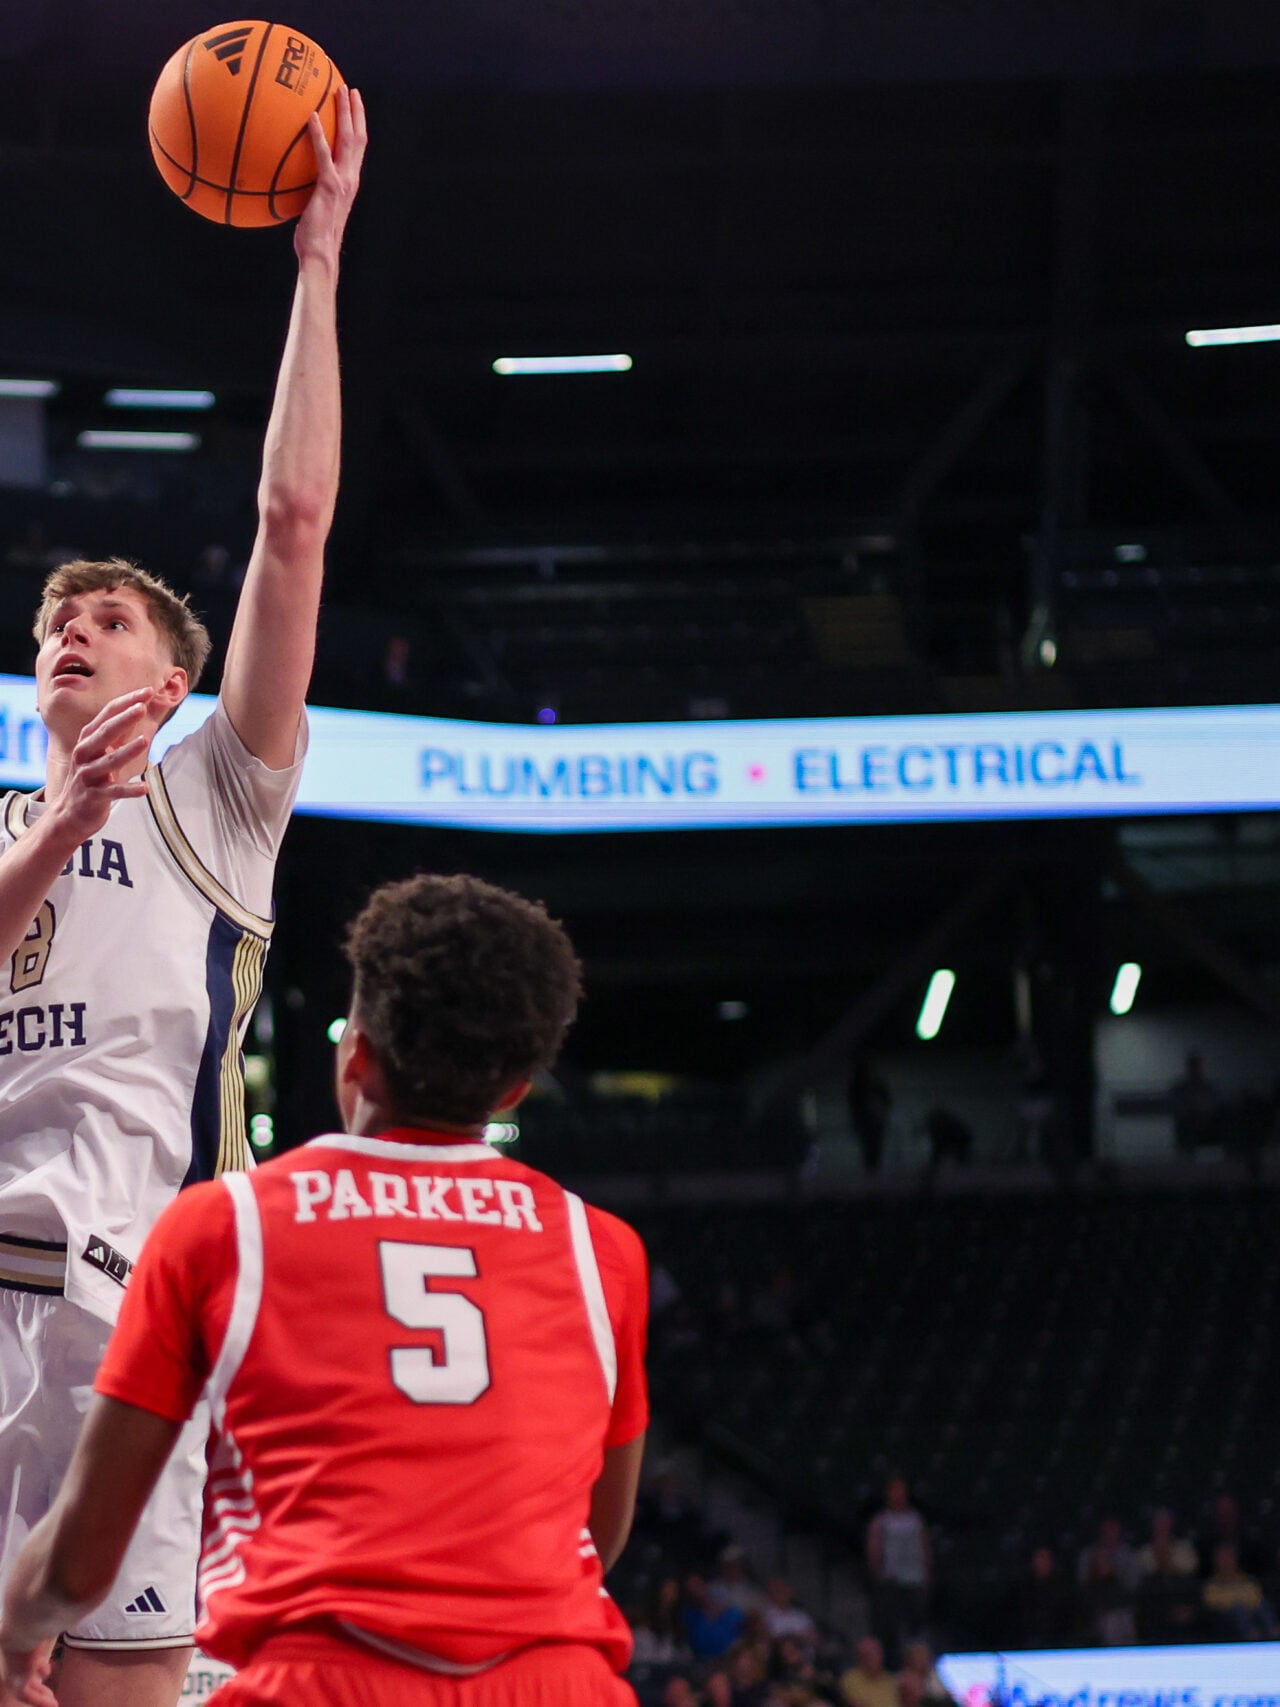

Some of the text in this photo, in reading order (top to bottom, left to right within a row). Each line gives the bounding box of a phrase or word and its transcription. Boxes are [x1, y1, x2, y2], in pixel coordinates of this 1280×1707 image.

[275, 36, 306, 90] PRO
[418, 737, 1143, 796] PLUMBING ELECTRICAL
[10, 898, 57, 995] 8
[289, 1169, 544, 1232] PARKER
[377, 1239, 491, 1405] 5
